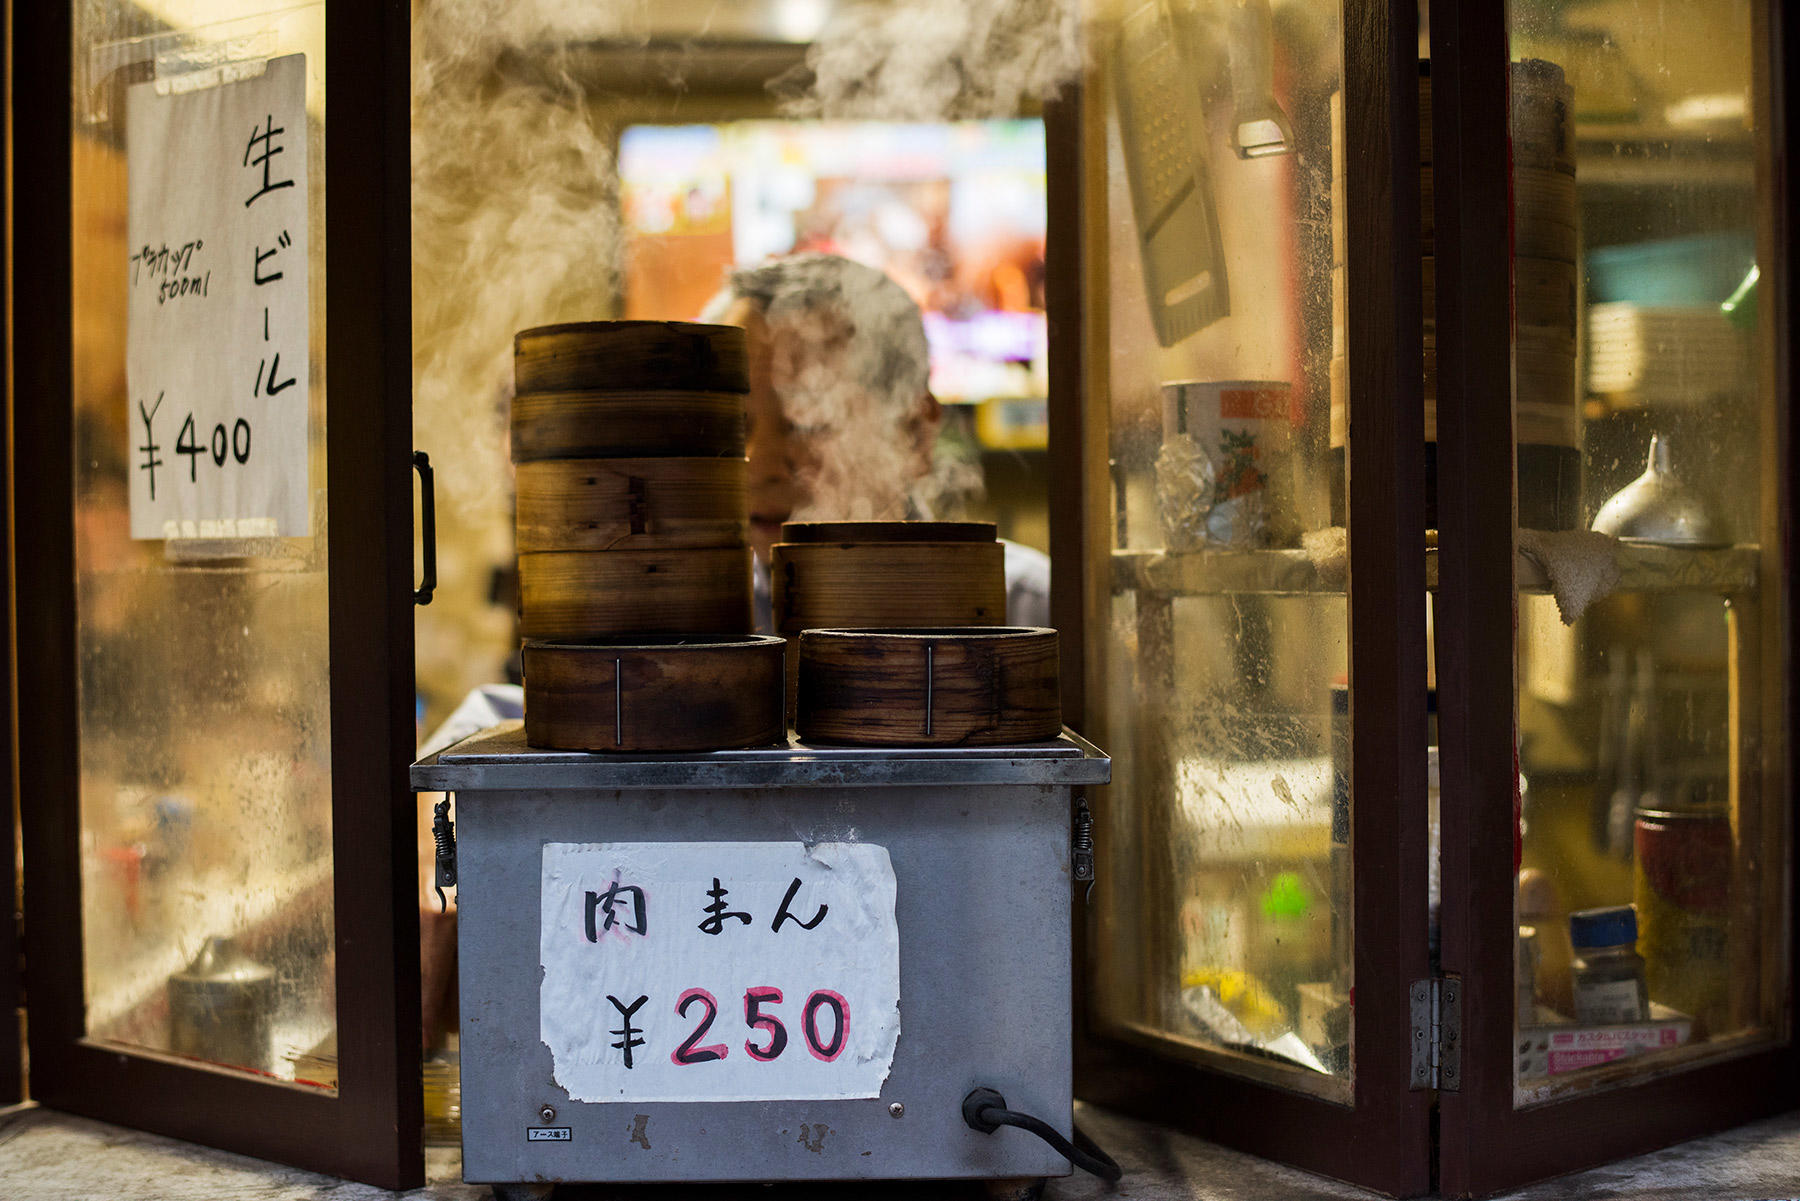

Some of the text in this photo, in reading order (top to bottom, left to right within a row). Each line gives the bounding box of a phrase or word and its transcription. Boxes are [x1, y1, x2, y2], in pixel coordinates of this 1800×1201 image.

[158, 269, 211, 305] 500ml
[243, 114, 296, 398] 生ビール
[138, 391, 251, 501] ¥400
[584, 877, 829, 943] 肉まん
[606, 986, 852, 1069] ¥250
